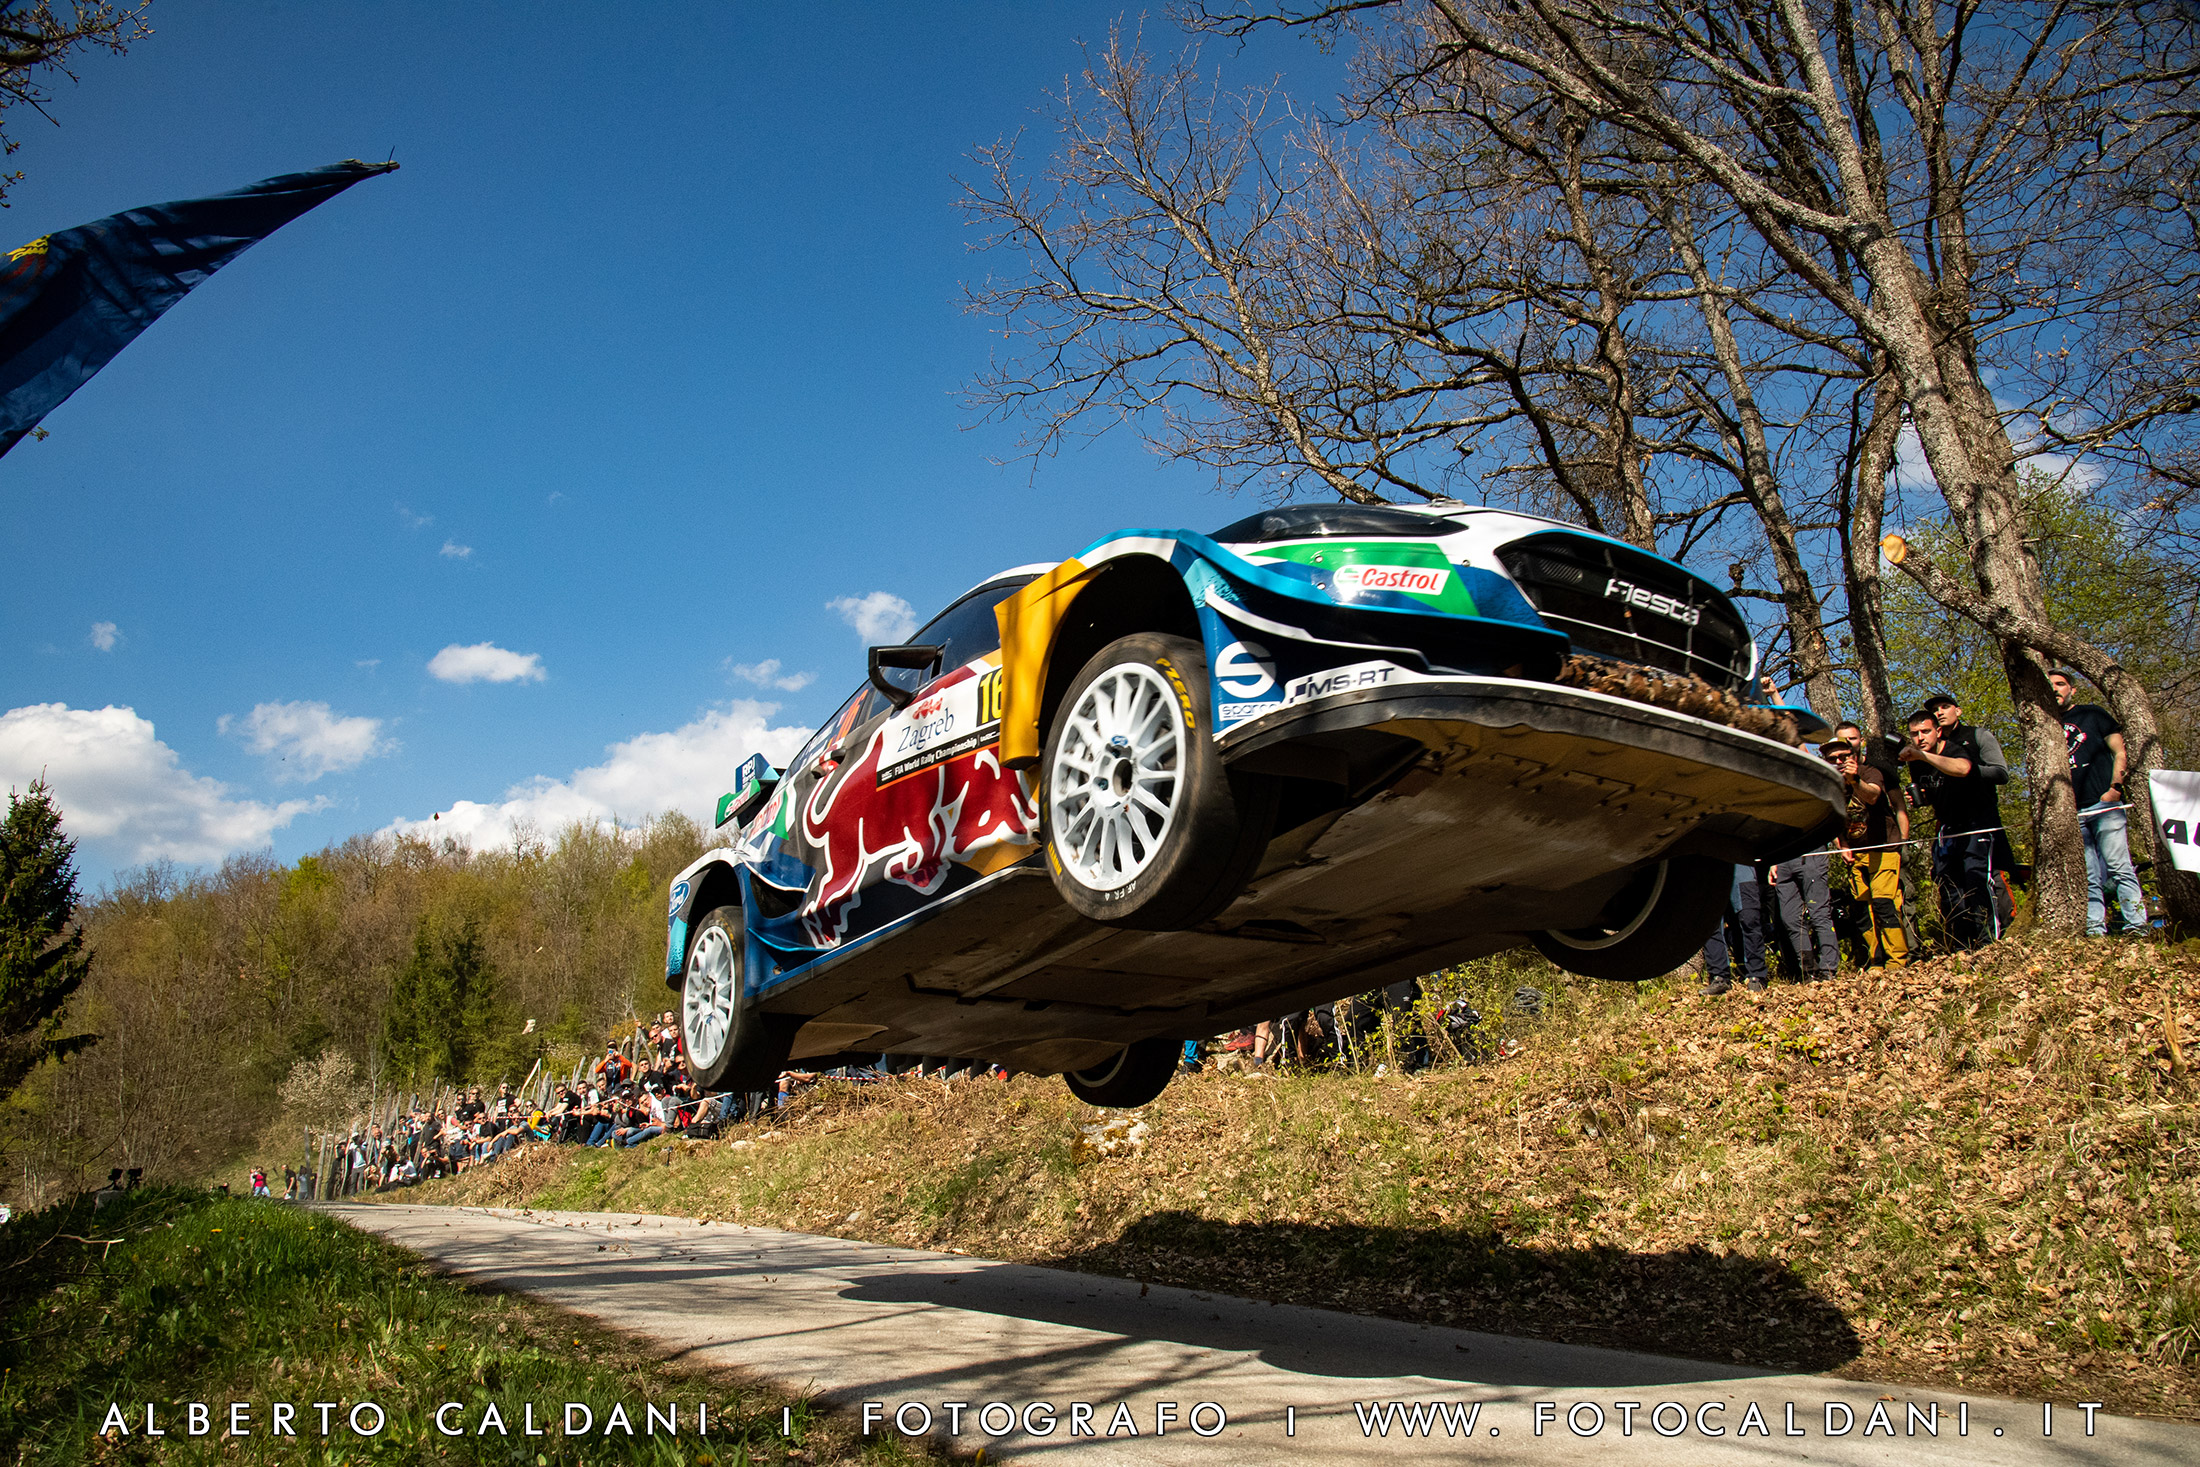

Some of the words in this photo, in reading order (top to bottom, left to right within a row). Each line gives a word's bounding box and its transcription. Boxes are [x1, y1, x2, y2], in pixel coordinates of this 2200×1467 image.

[1361, 568, 1439, 591] Castrol
[1604, 578, 1700, 626] Fiesta
[980, 667, 1002, 724] 16
[897, 707, 955, 753] Zagreb
[894, 765, 904, 776] FIA
[904, 757, 920, 772] World
[920, 752, 935, 765] Rally
[935, 737, 978, 760] Championship
